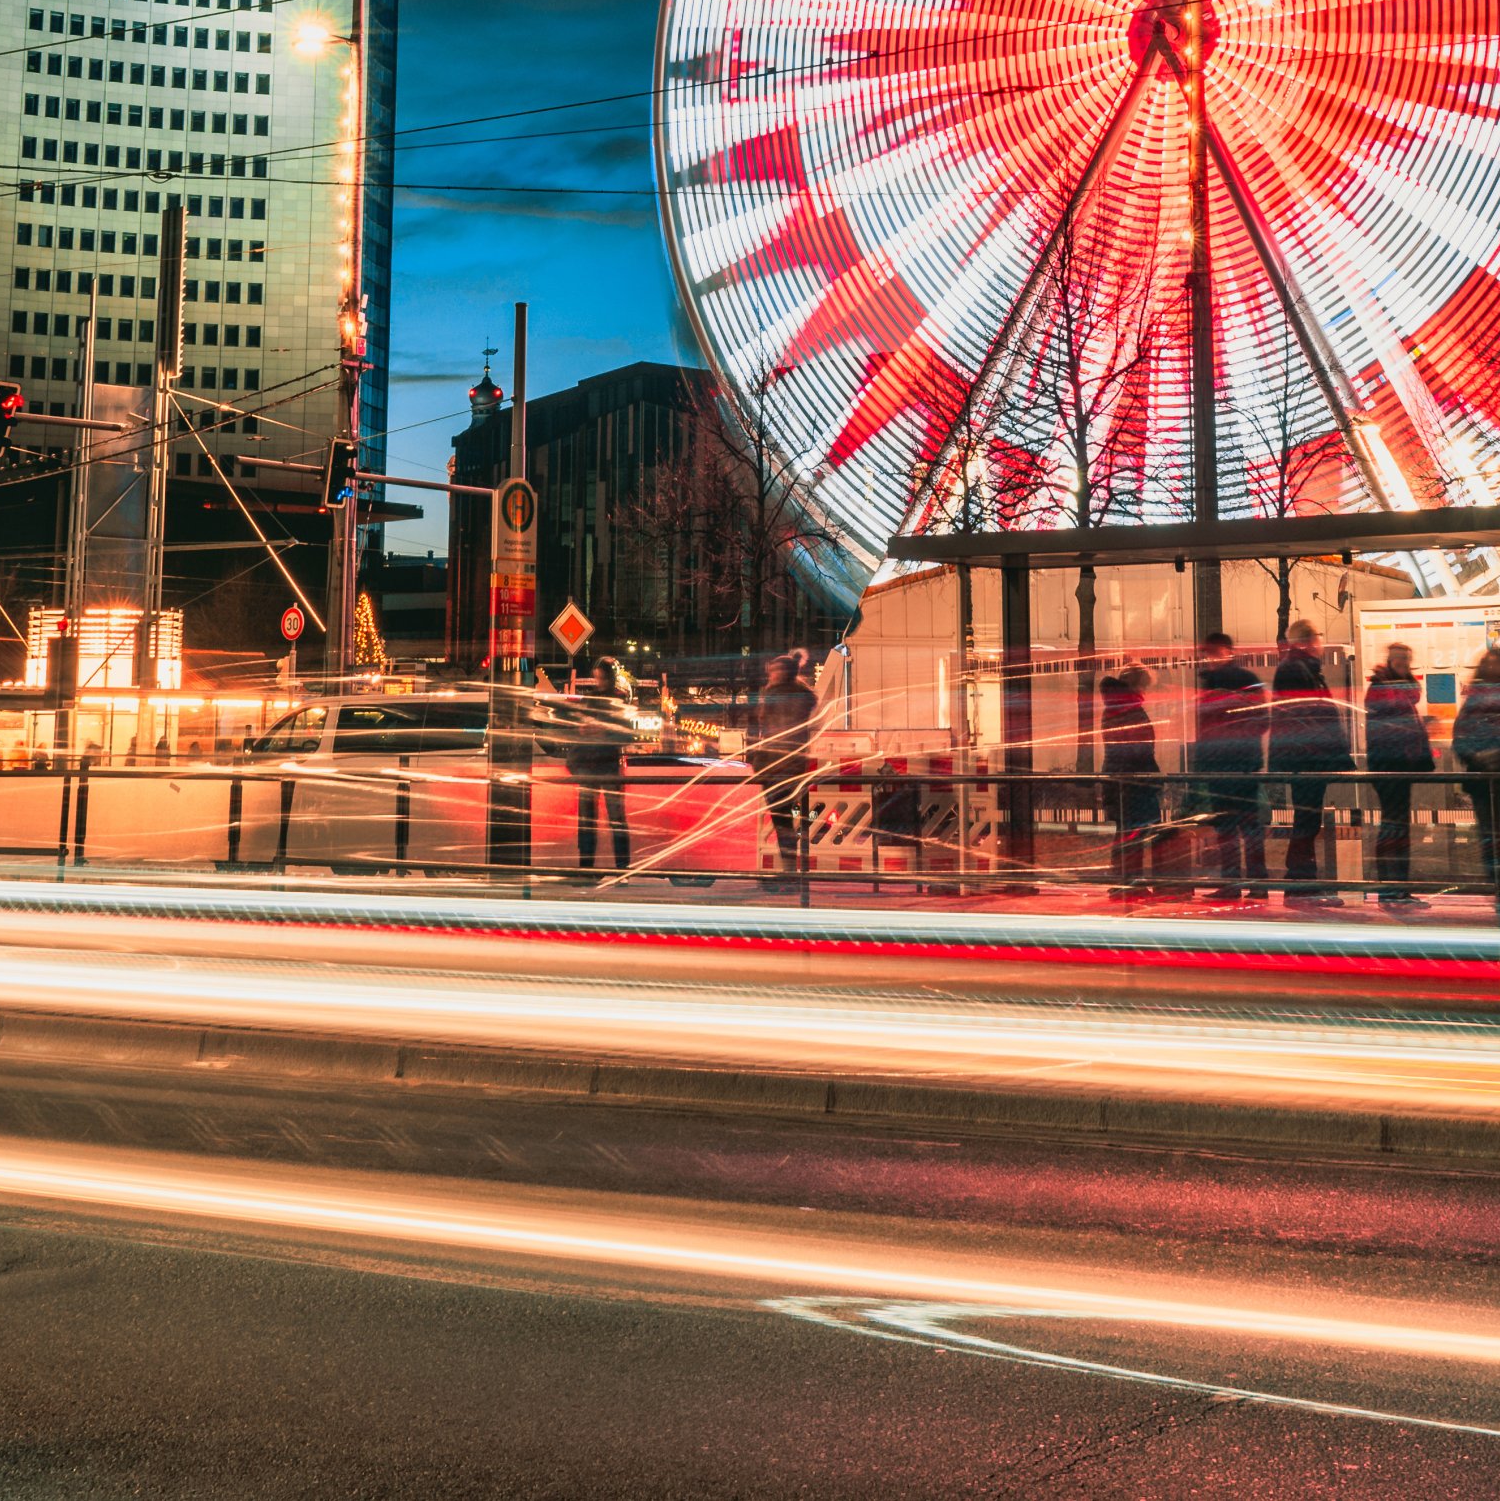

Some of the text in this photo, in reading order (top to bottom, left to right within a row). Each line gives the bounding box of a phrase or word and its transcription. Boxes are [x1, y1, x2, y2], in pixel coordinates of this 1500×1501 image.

[503, 574, 510, 587] 8
[500, 588, 510, 601] 10
[501, 602, 509, 615] 11
[286, 617, 299, 631] 30
